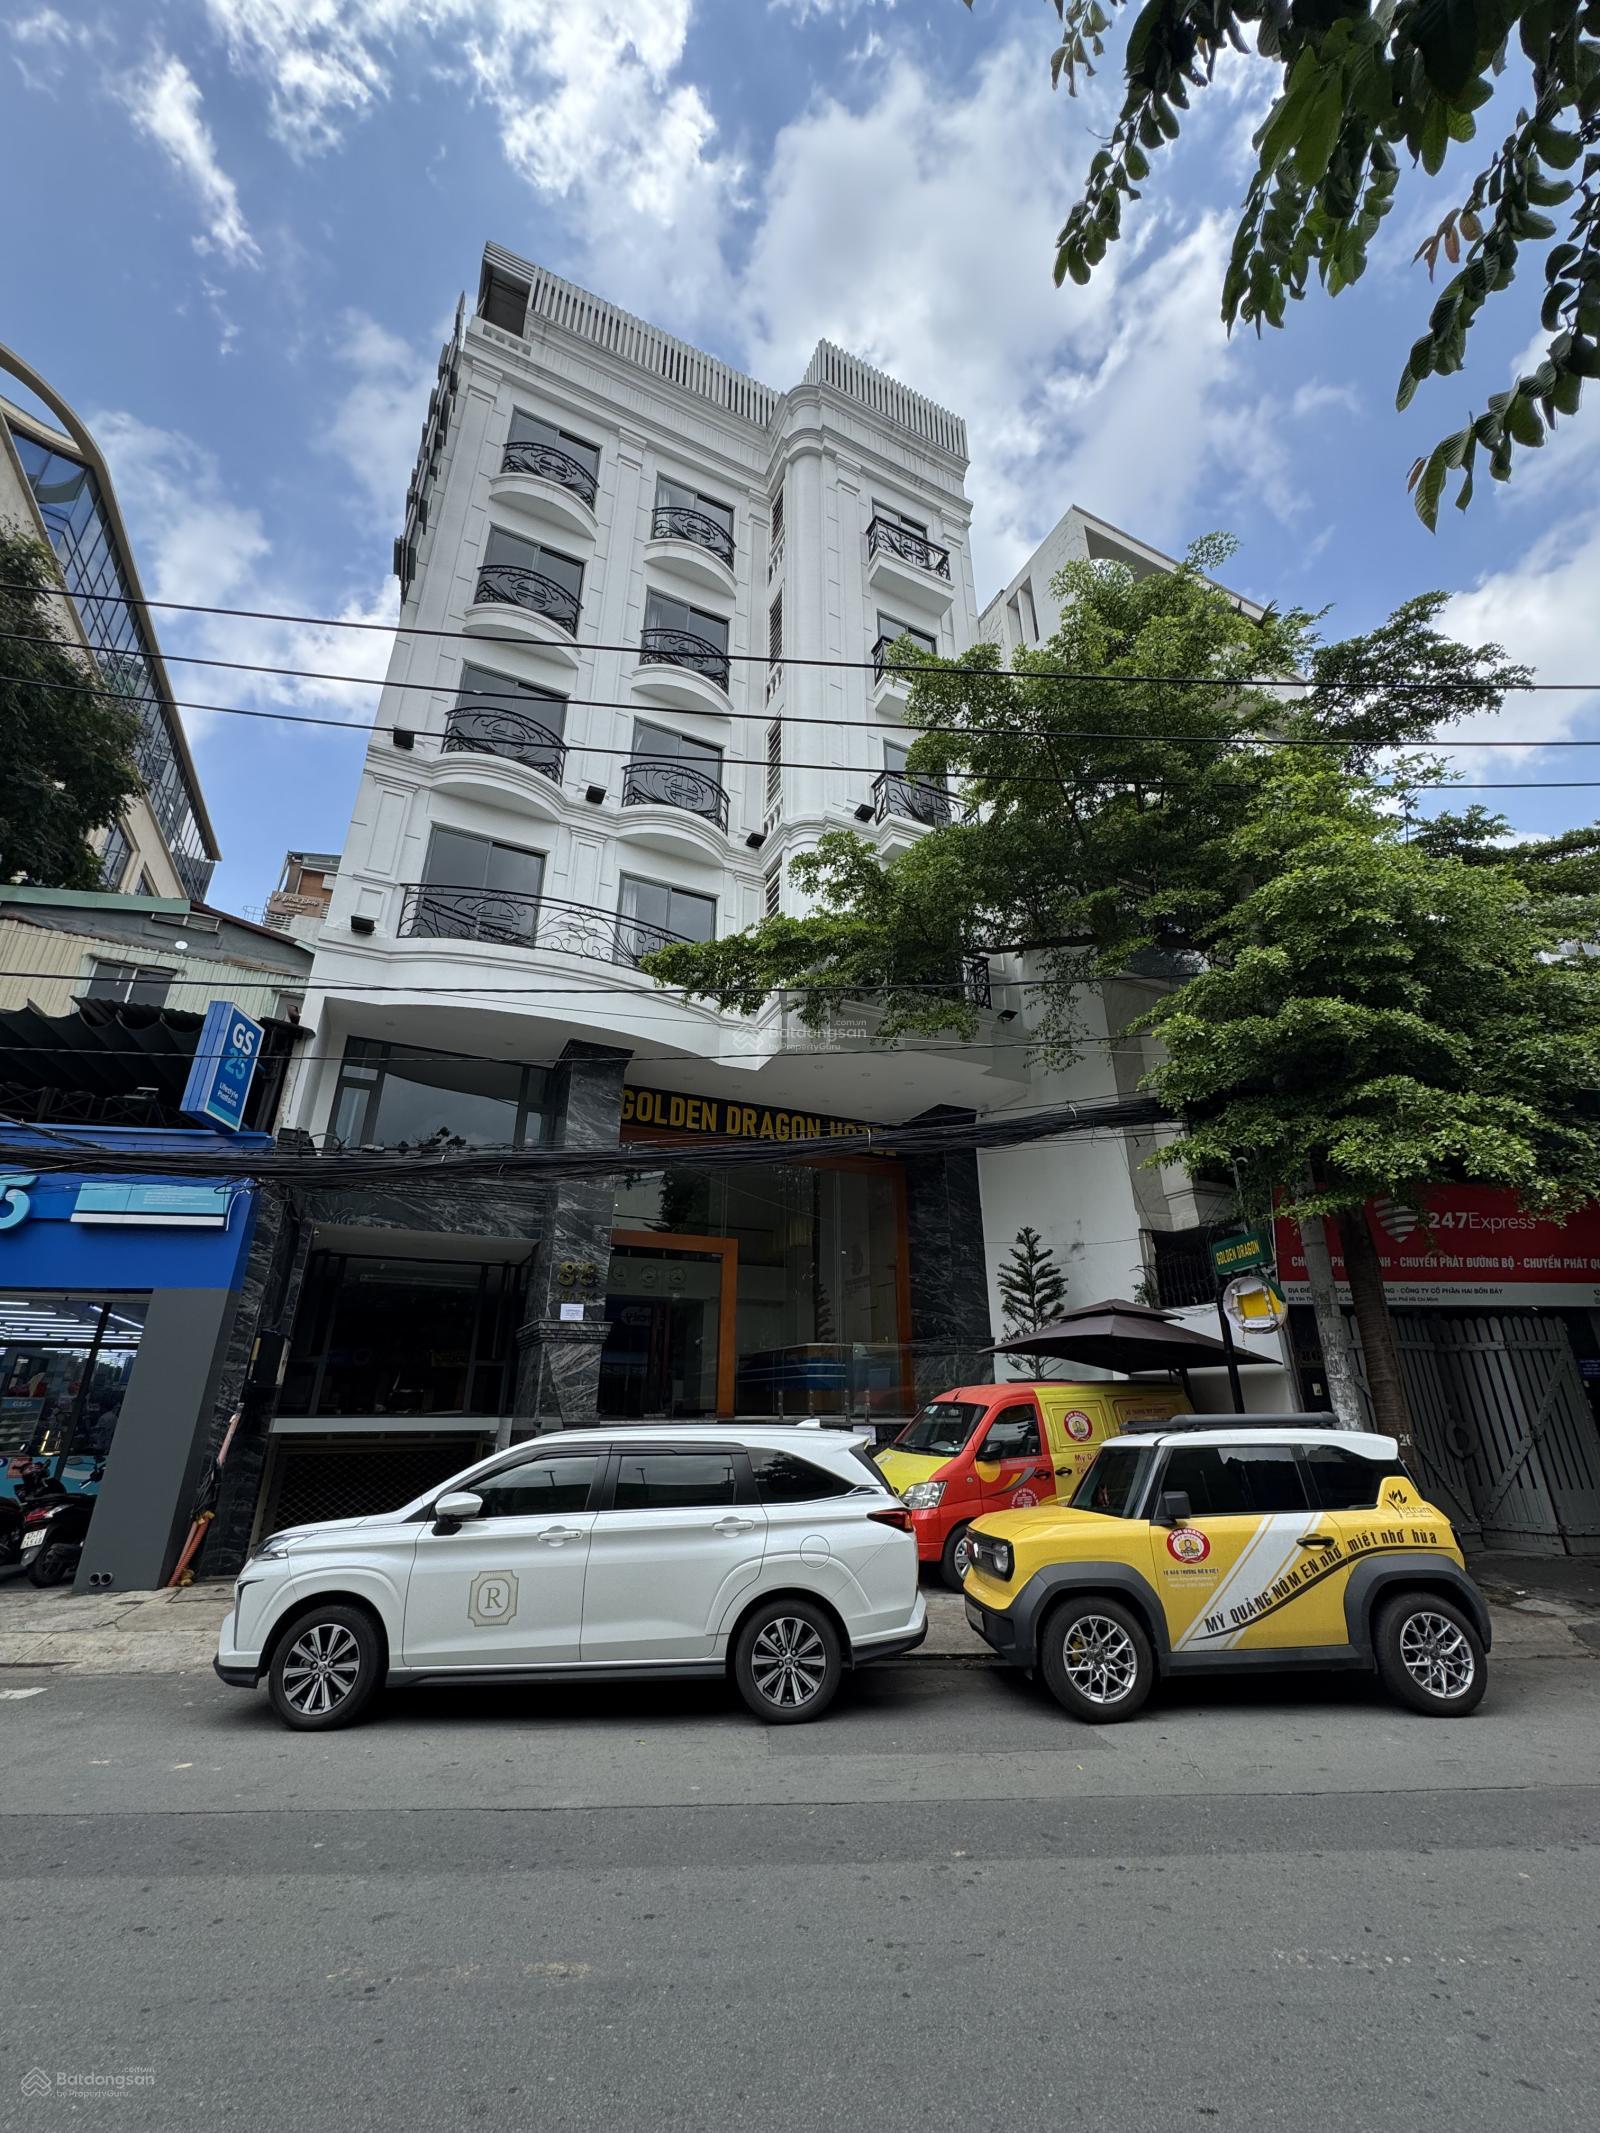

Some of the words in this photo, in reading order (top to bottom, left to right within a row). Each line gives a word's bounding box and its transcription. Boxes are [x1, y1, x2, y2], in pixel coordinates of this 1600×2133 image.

[232, 1023, 255, 1055] GS
[225, 1047, 249, 1080] 25
[621, 1089, 718, 1132] GOLDEN
[725, 1105, 821, 1143] DRAGON
[1428, 1211, 1537, 1234] 247Express
[1215, 1247, 1238, 1265] GOLDEN
[1236, 1239, 1261, 1259] DRAGON
[1501, 1256, 1515, 1270] BỘ
[1299, 1558, 1320, 1580] EN
[1346, 1530, 1378, 1553] miết
[484, 1586, 503, 1609] R
